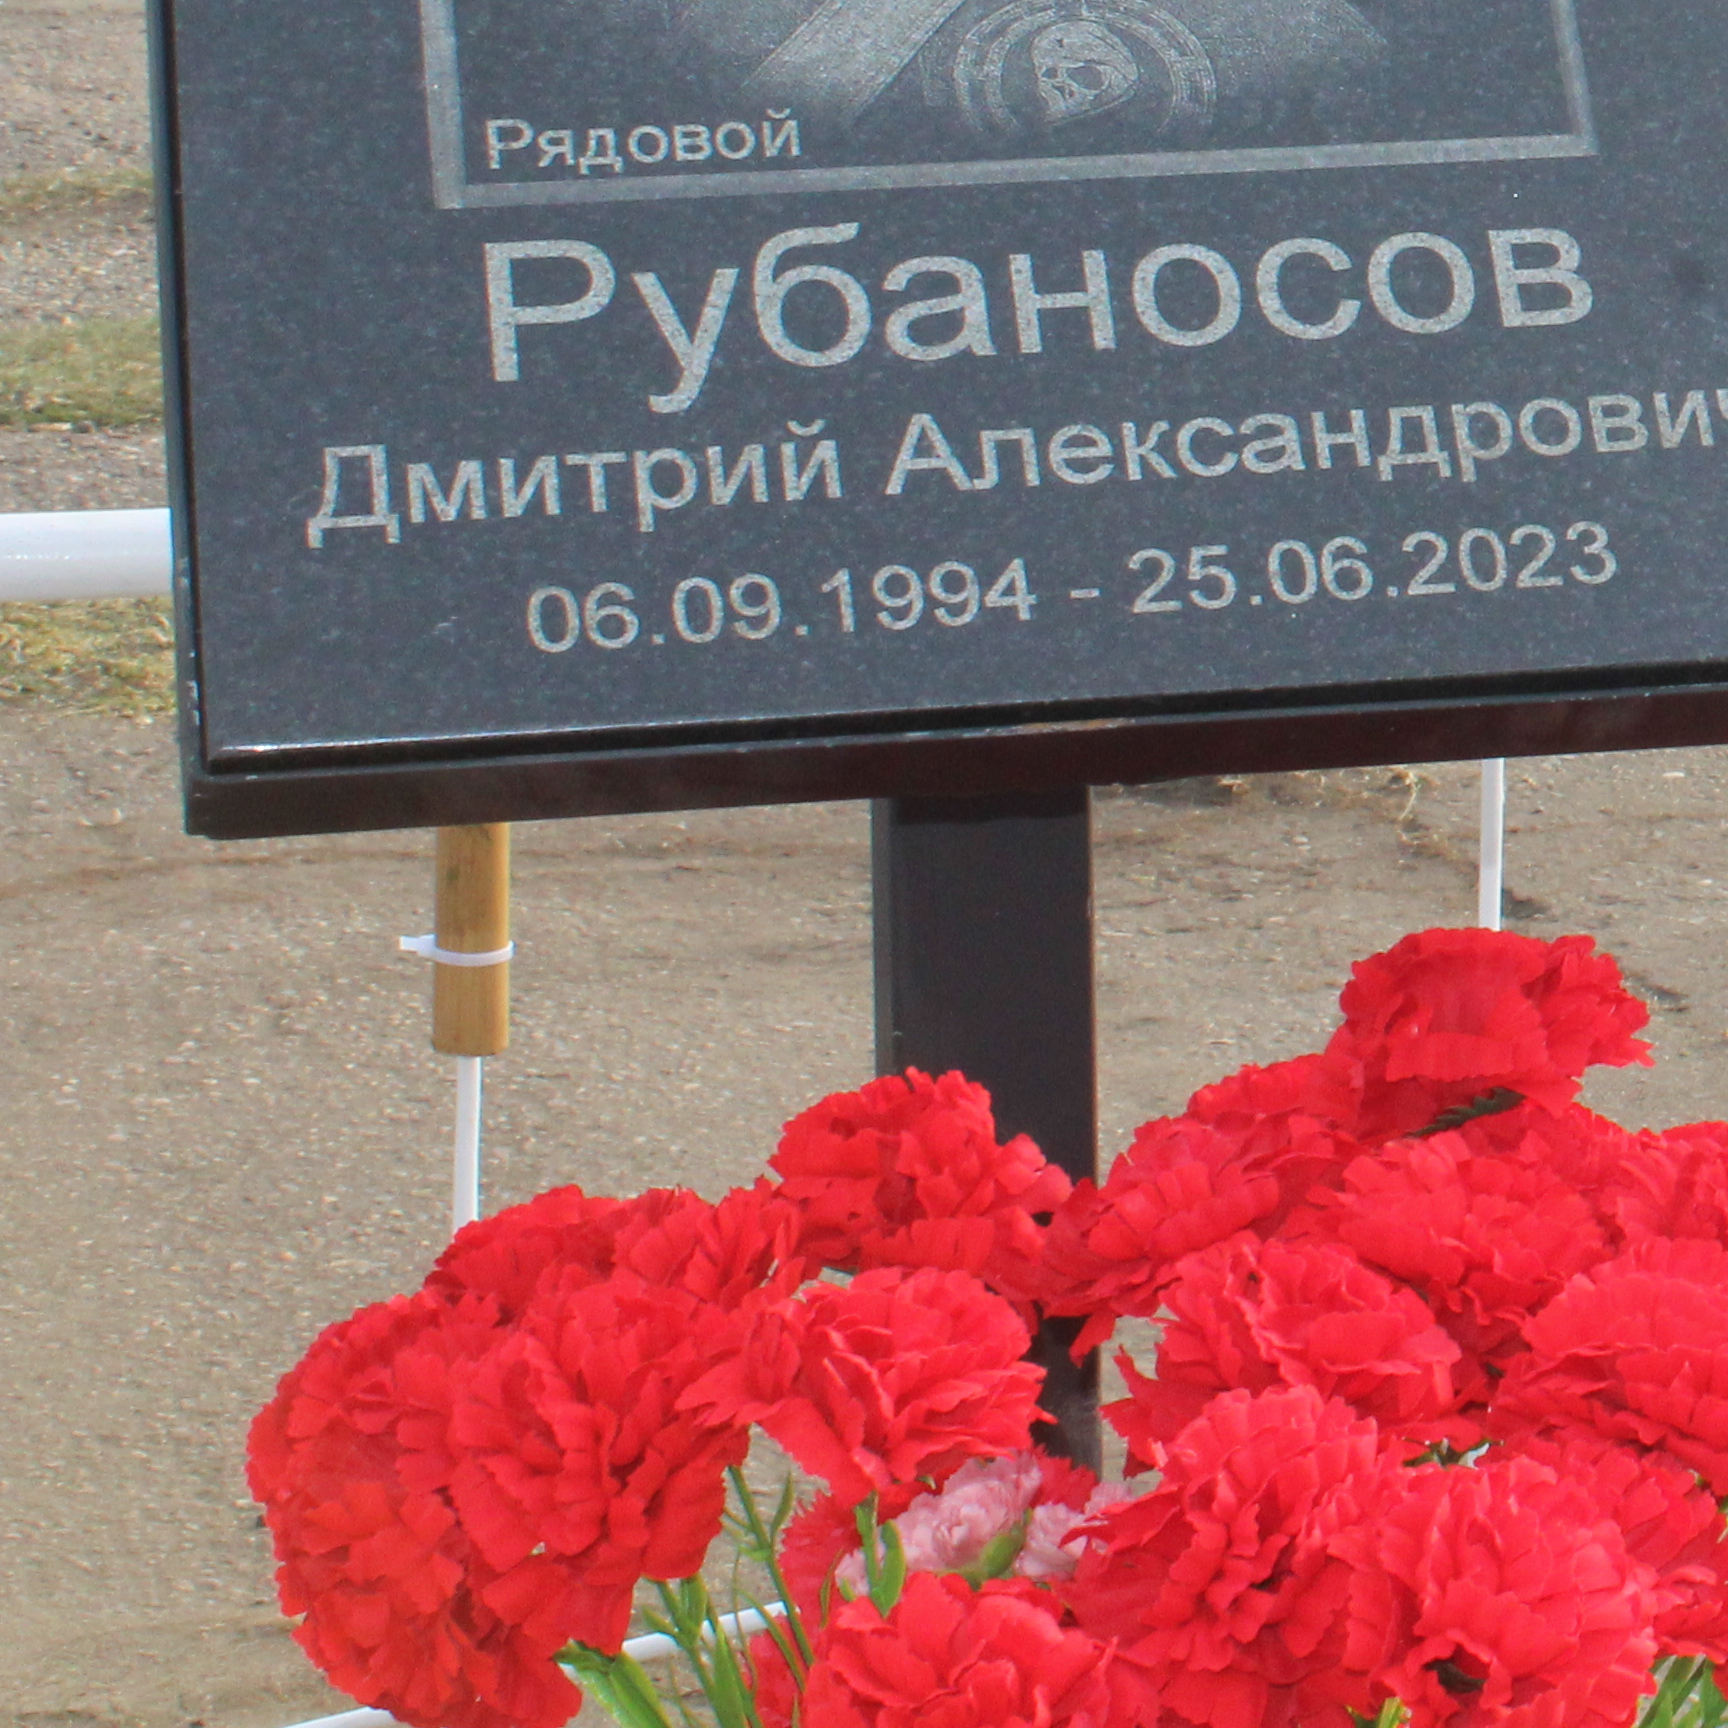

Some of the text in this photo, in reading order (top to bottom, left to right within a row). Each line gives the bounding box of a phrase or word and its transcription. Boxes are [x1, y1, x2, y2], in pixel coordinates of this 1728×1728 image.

[486, 108, 800, 174] Рядовой
[484, 223, 1593, 413] Рубаносов
[307, 420, 841, 548] Дмитрий
[527, 558, 1036, 653] 06.09.1994
[1128, 521, 1617, 613] 25.06.2023
